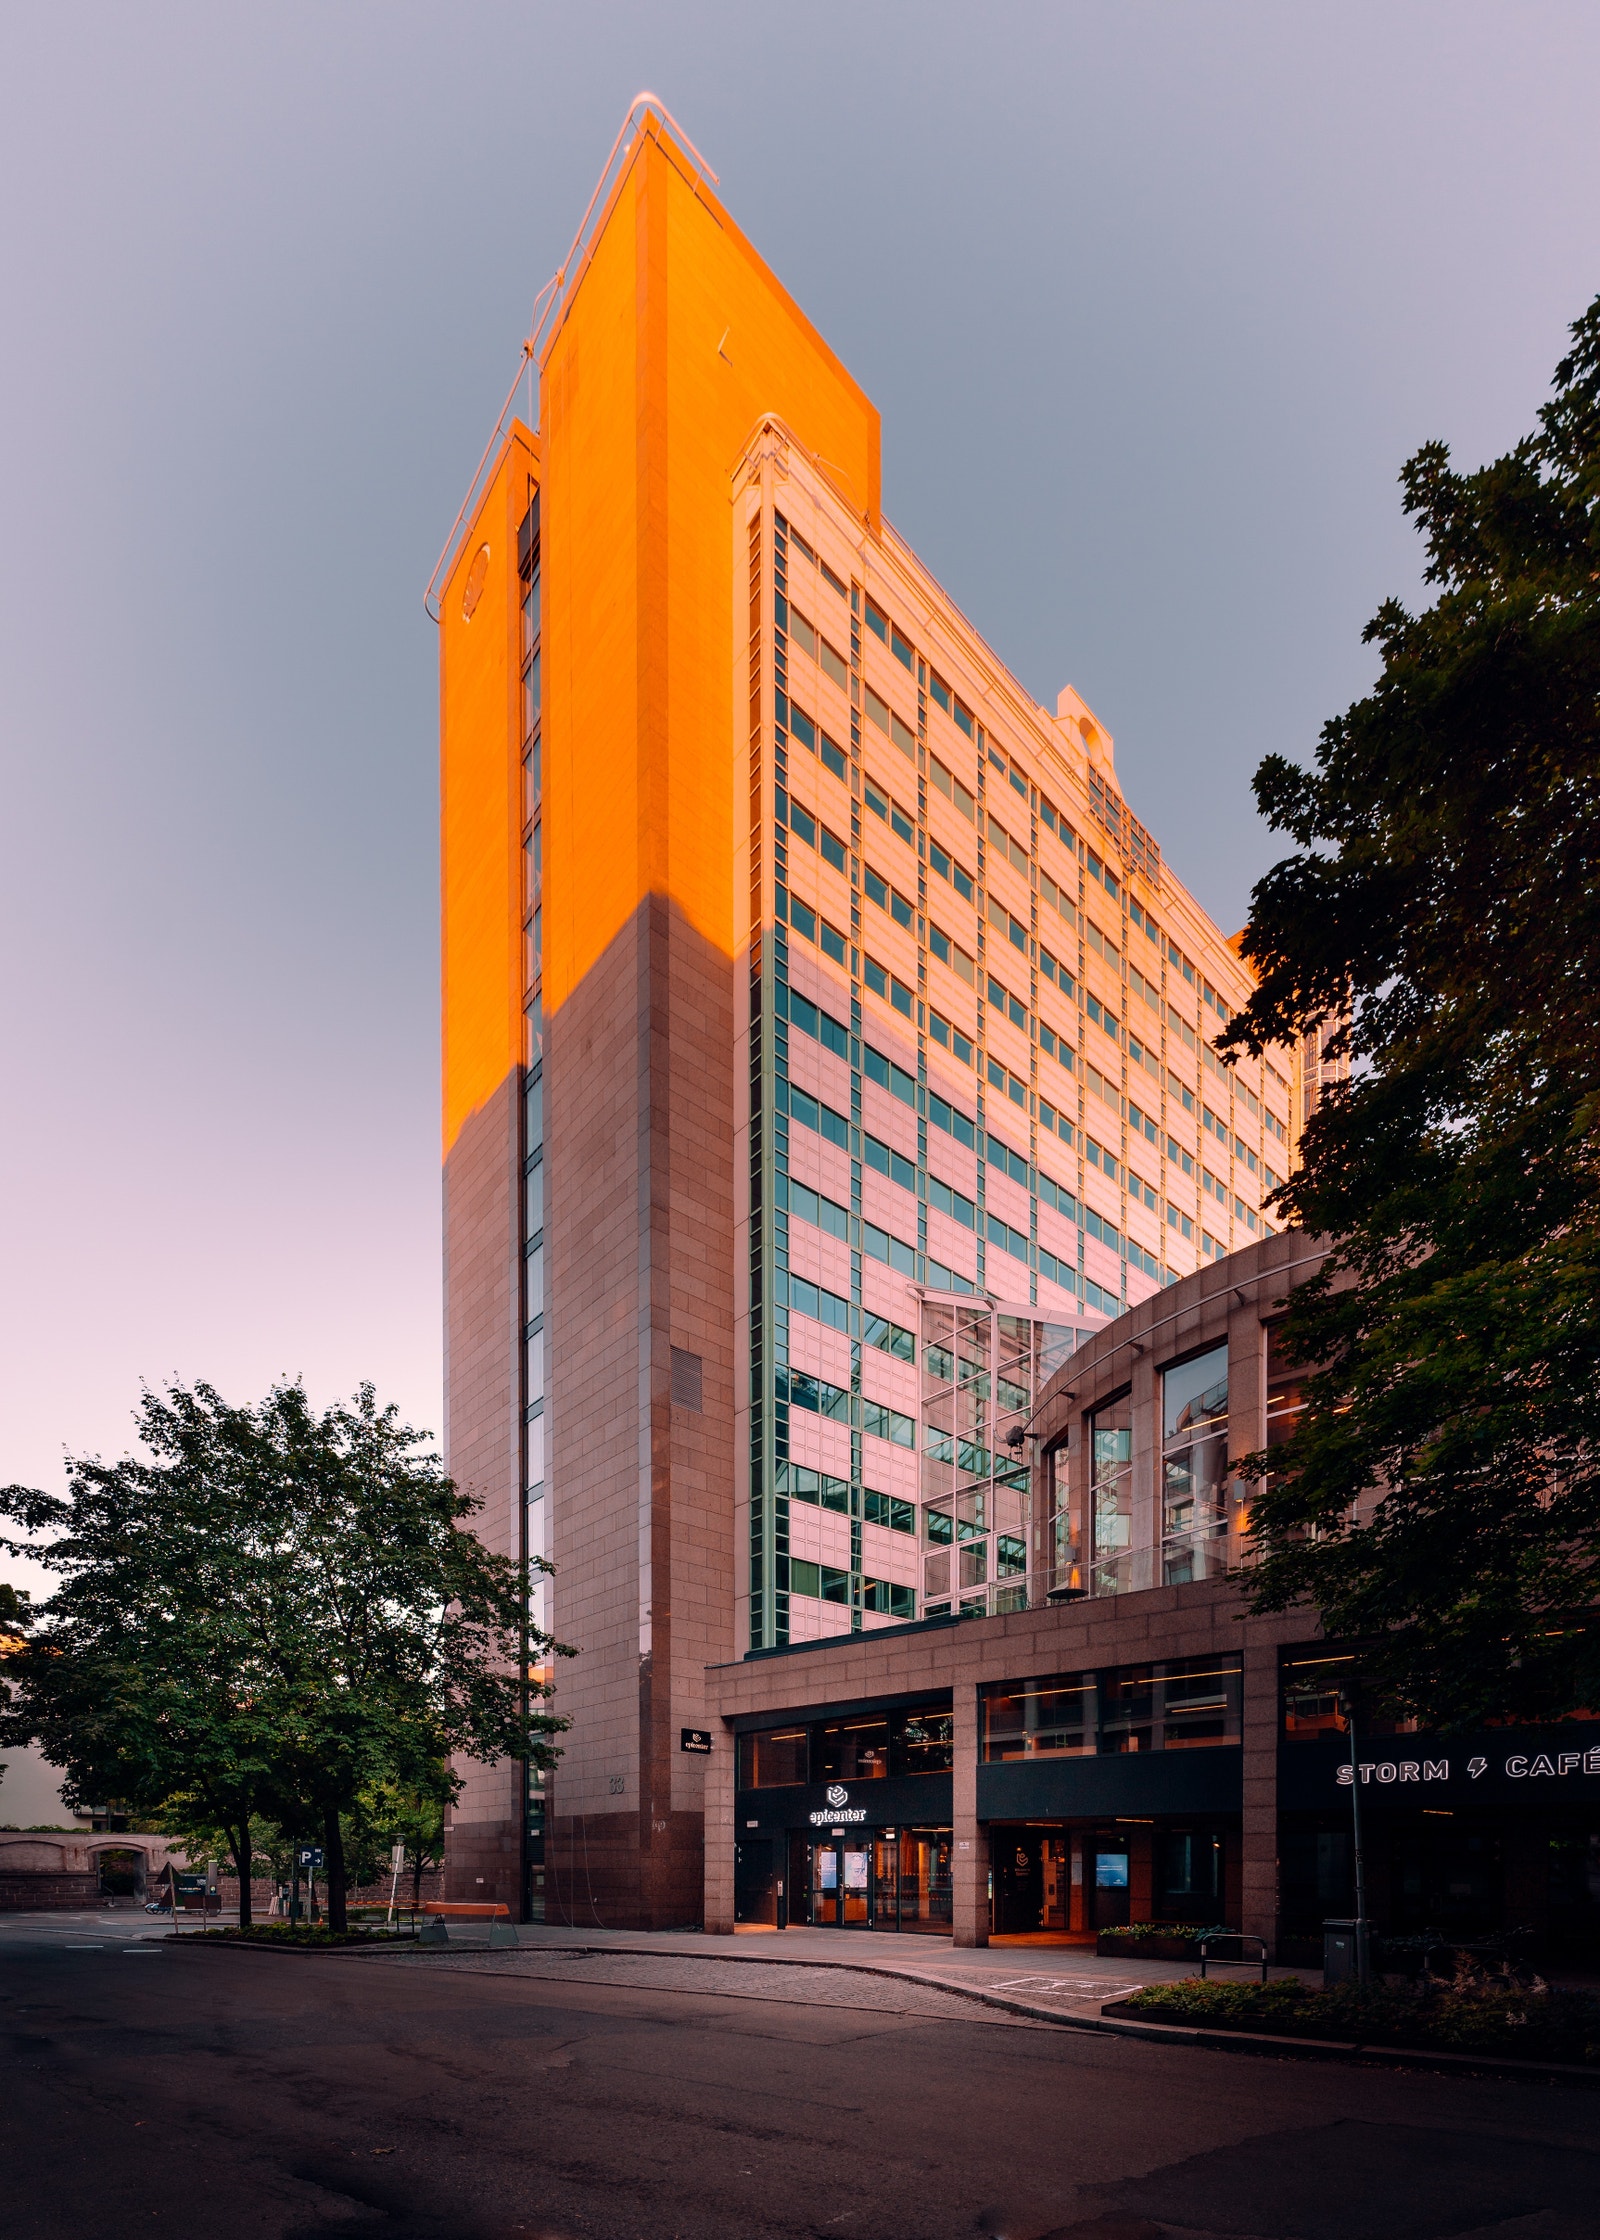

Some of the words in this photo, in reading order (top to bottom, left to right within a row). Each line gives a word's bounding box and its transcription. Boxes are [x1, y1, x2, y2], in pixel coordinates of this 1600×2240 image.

[1336, 1759, 1449, 1785] STORM
[1505, 1745, 1600, 1777] CAFÉ
[809, 1808, 866, 1826] epicenter
[301, 1851, 312, 1864] P
